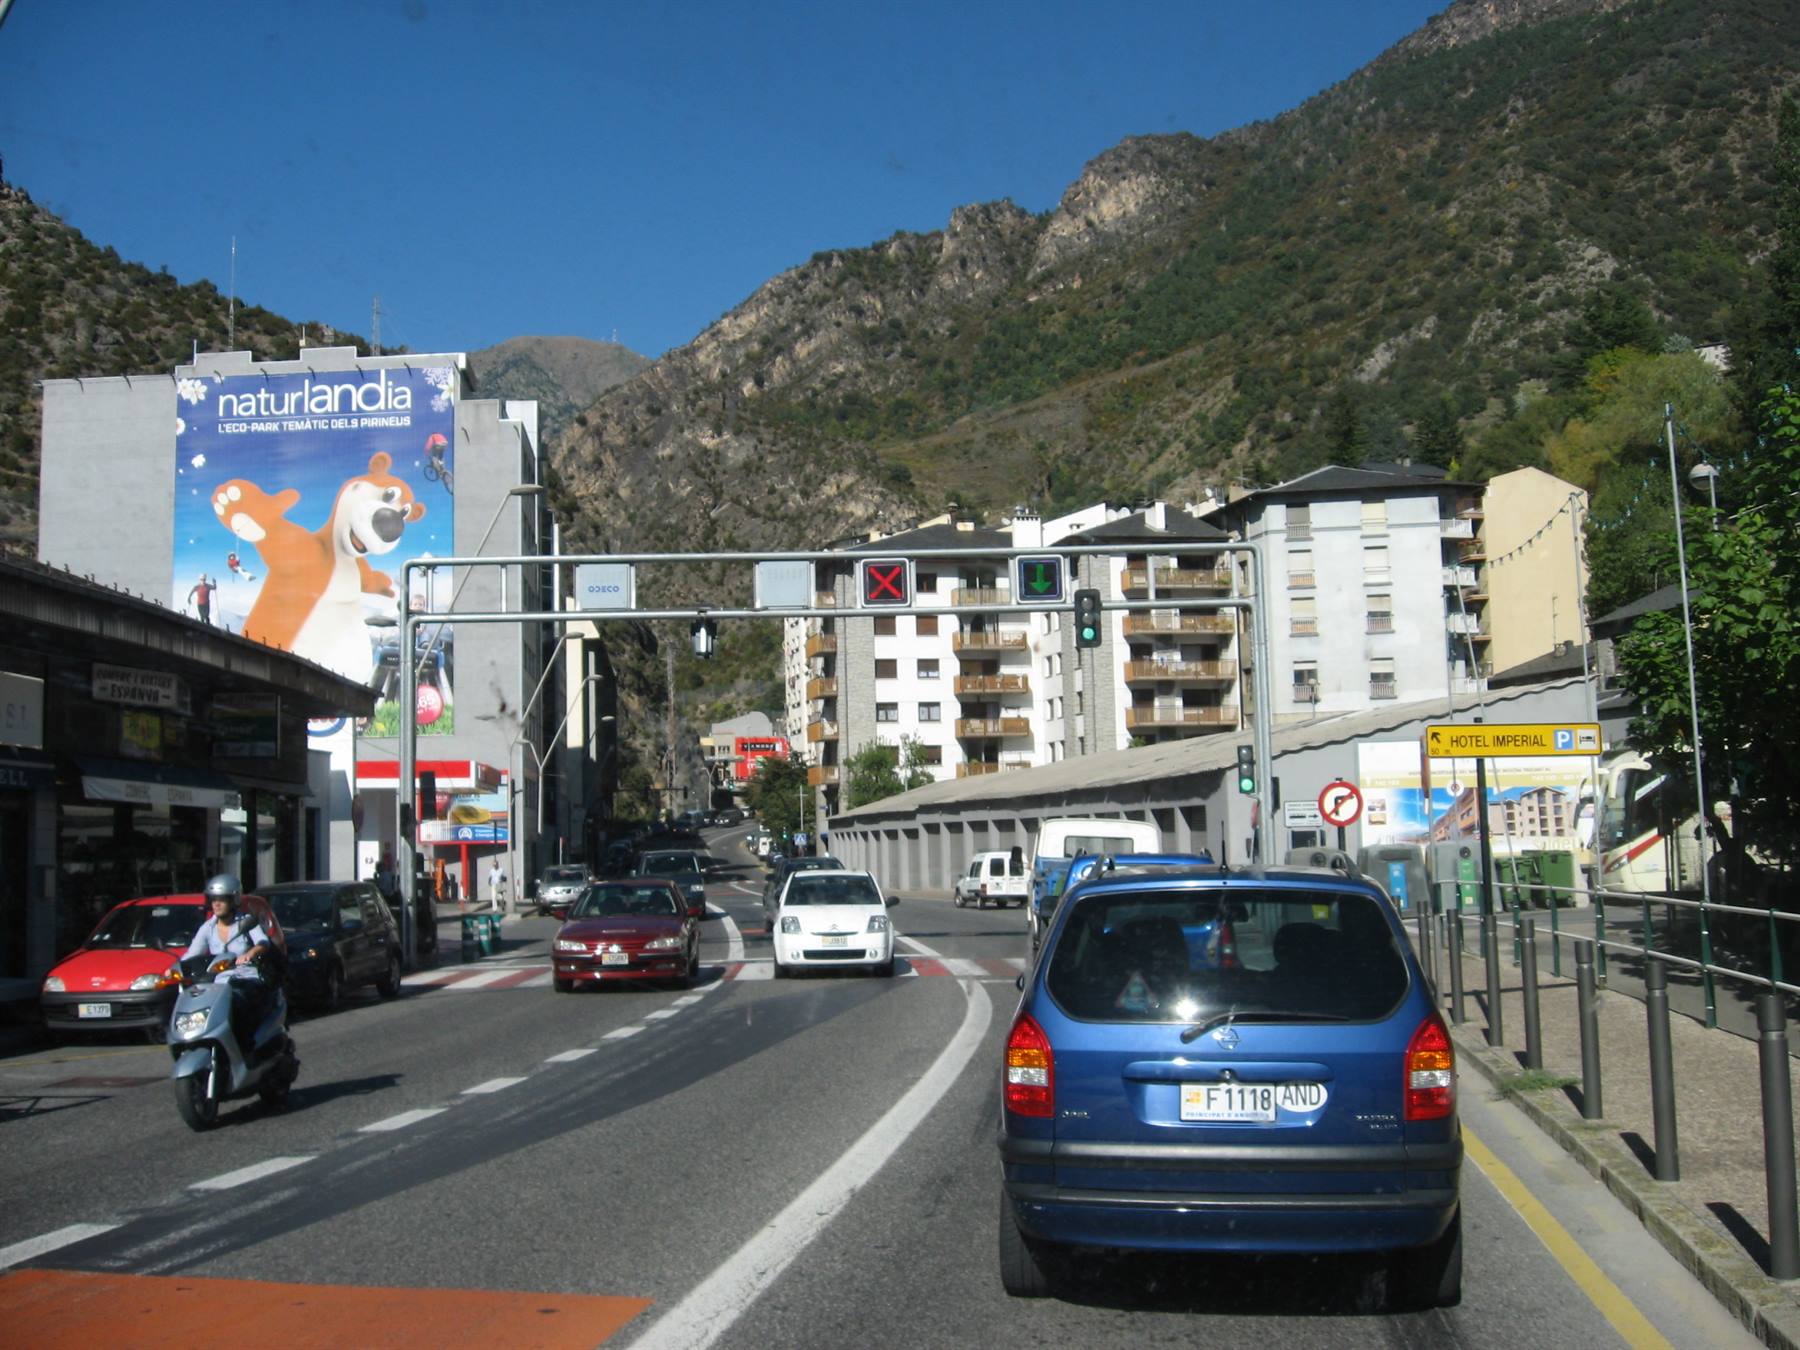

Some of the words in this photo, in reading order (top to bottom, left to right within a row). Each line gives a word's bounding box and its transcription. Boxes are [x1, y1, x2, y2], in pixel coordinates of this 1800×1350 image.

[218, 369, 412, 417] naturlandia
[218, 421, 279, 434] L'ECO-PARK
[282, 418, 329, 431] TEMÀTIC
[331, 419, 358, 430] DELS
[360, 416, 411, 428] PIRINEUS
[1450, 735, 1489, 748] HOTEL
[1493, 735, 1547, 747] IMPERIAL
[1206, 1087, 1272, 1111] F1118
[1282, 1083, 1321, 1106] AND
